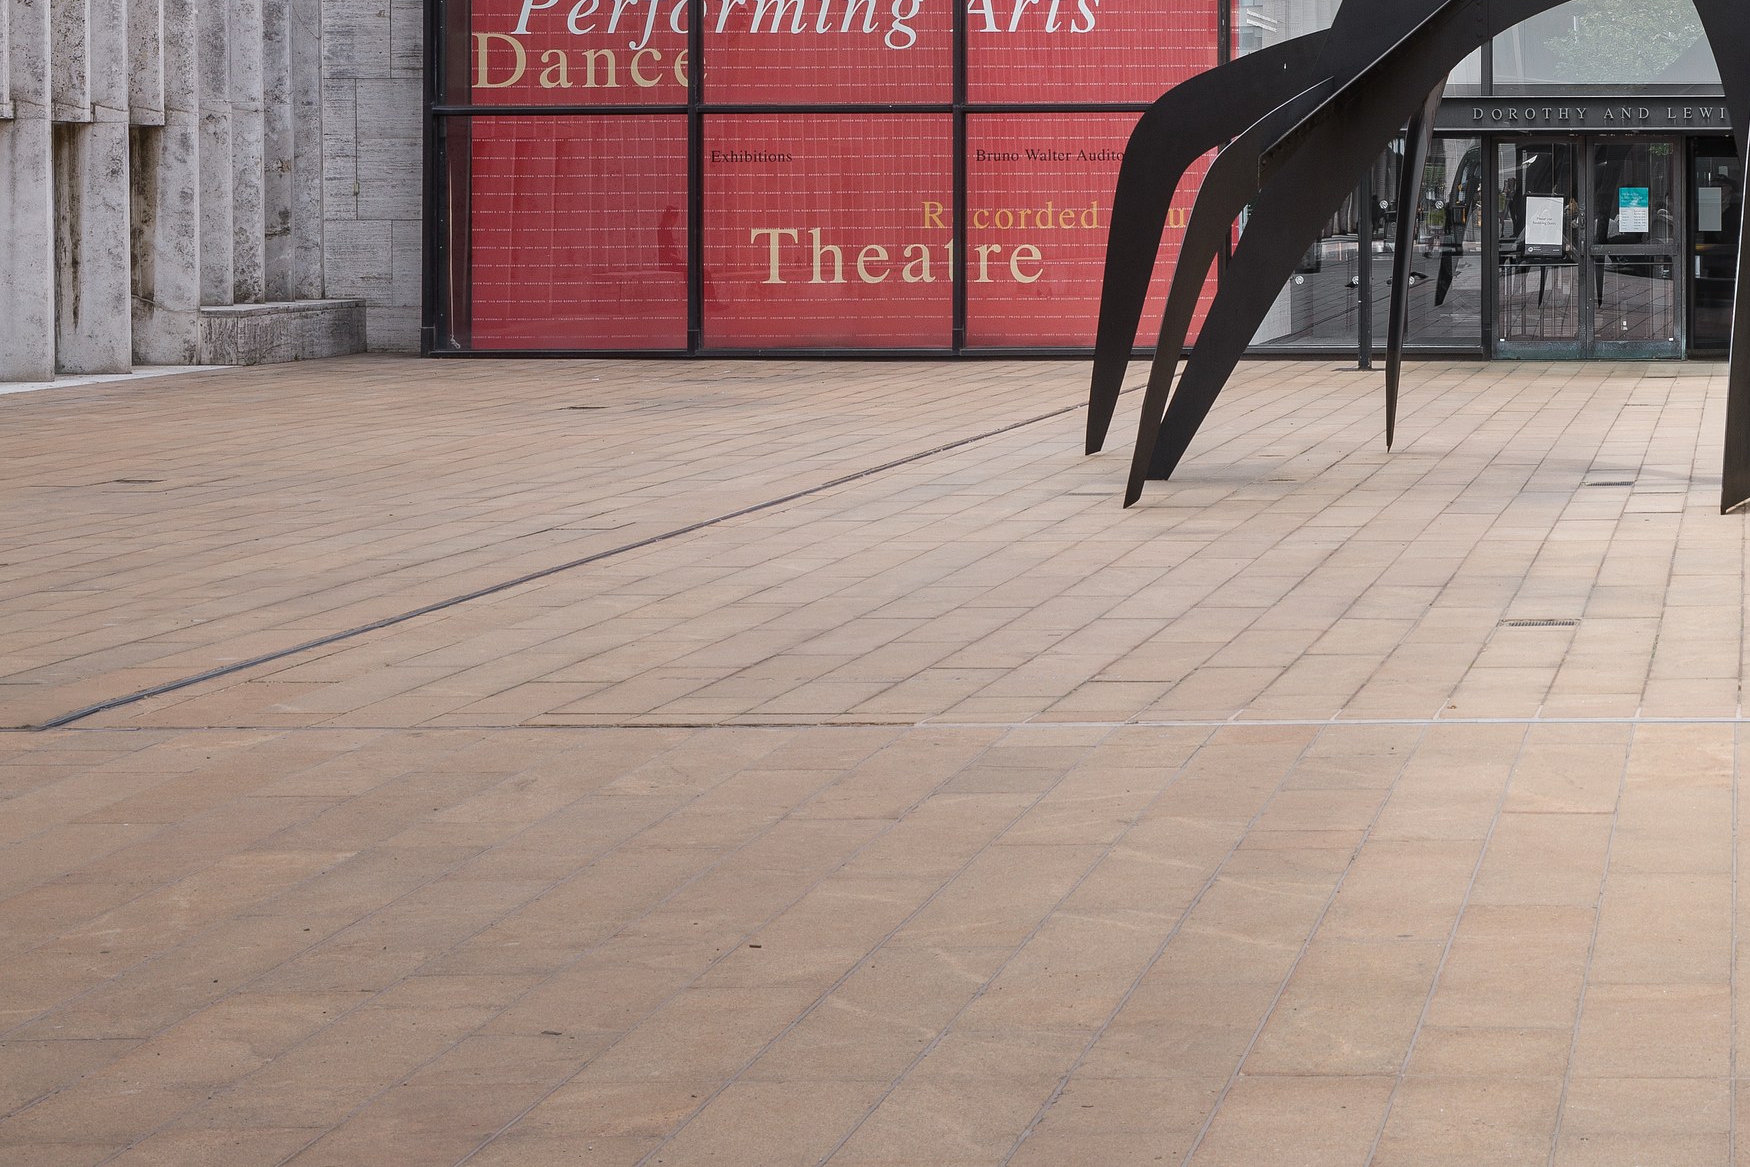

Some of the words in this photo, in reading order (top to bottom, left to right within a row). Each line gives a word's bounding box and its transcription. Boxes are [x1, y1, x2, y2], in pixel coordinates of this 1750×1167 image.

[472, 32, 708, 89] Dance
[1472, 106, 1587, 121] DOROTHY
[1603, 106, 1650, 120] AND
[1666, 106, 1726, 120] LEWI
[711, 149, 793, 163] Exhibitions
[976, 148, 1020, 162] Bruno
[1025, 148, 1072, 162] Walter
[1076, 148, 1125, 162] Audito
[922, 200, 1100, 230] Rcorded
[749, 225, 1045, 285] Theatre
